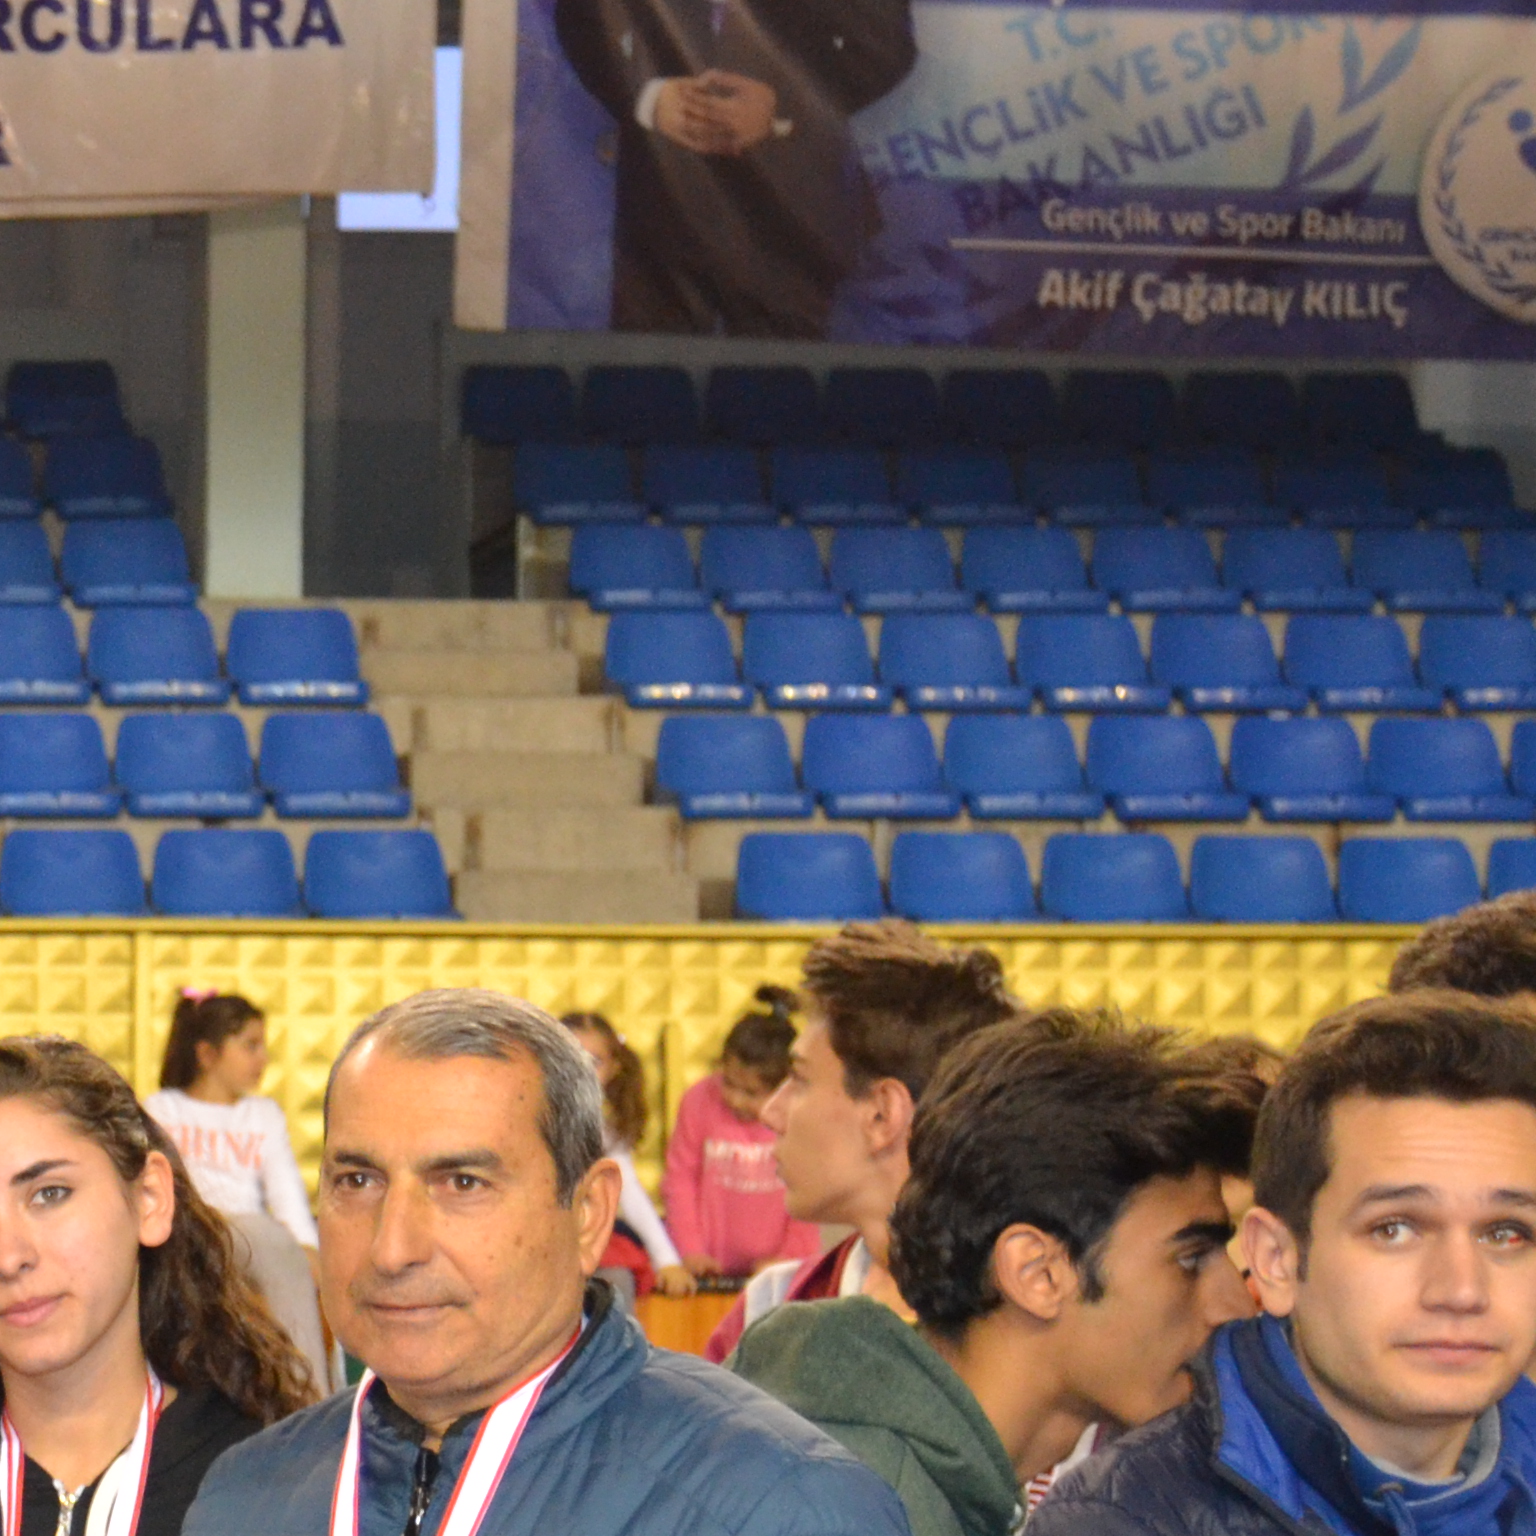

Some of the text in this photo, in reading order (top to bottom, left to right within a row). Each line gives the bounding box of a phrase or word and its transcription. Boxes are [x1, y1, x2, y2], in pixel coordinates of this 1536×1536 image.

[1088, 44, 1168, 99] VE
[1040, 199, 1406, 245] Gençlik ve Spor Bakanı
[1038, 268, 1409, 328] Akif Çağatay KILIÇ
